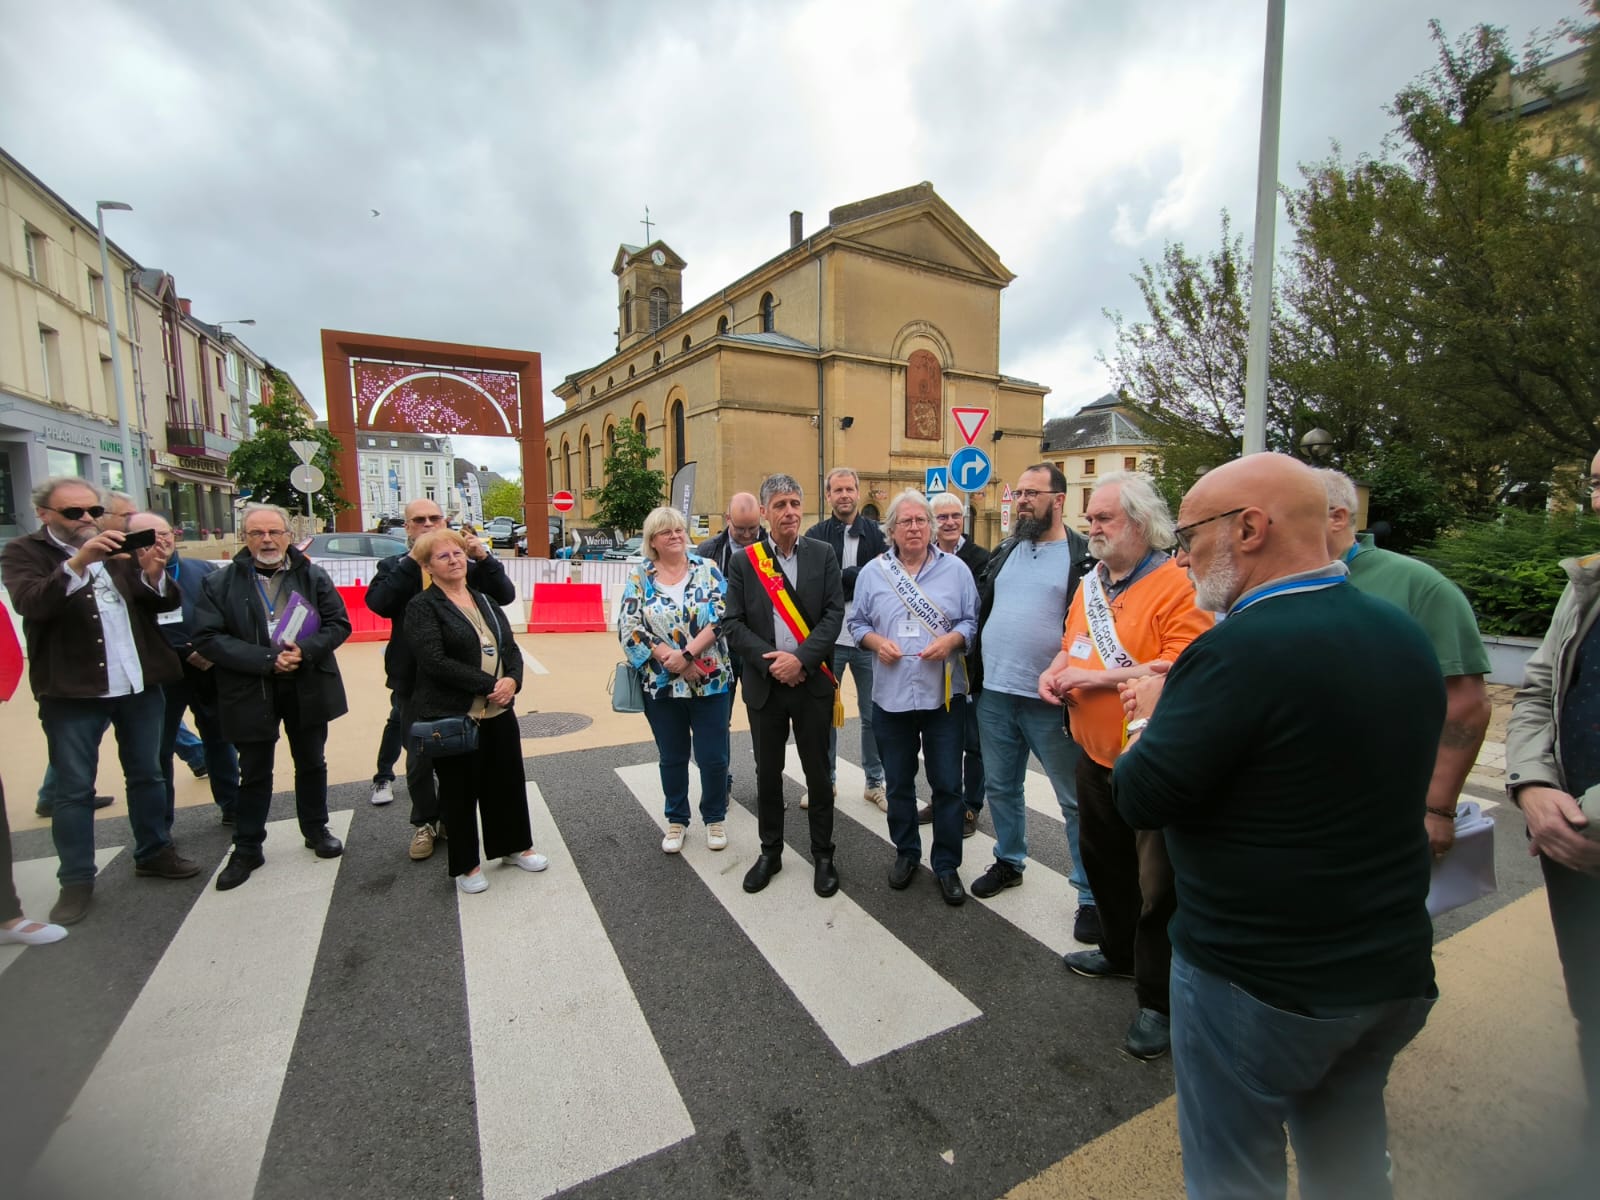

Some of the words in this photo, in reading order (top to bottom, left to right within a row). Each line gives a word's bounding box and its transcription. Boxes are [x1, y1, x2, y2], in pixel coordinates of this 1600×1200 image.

[890, 561, 901, 576] les
[900, 575, 920, 599] vieux
[918, 598, 939, 619] cons
[895, 581, 908, 596] 1er
[906, 597, 939, 630] dauphin
[1094, 594, 1108, 625] vieux
[1102, 624, 1117, 653] cons
